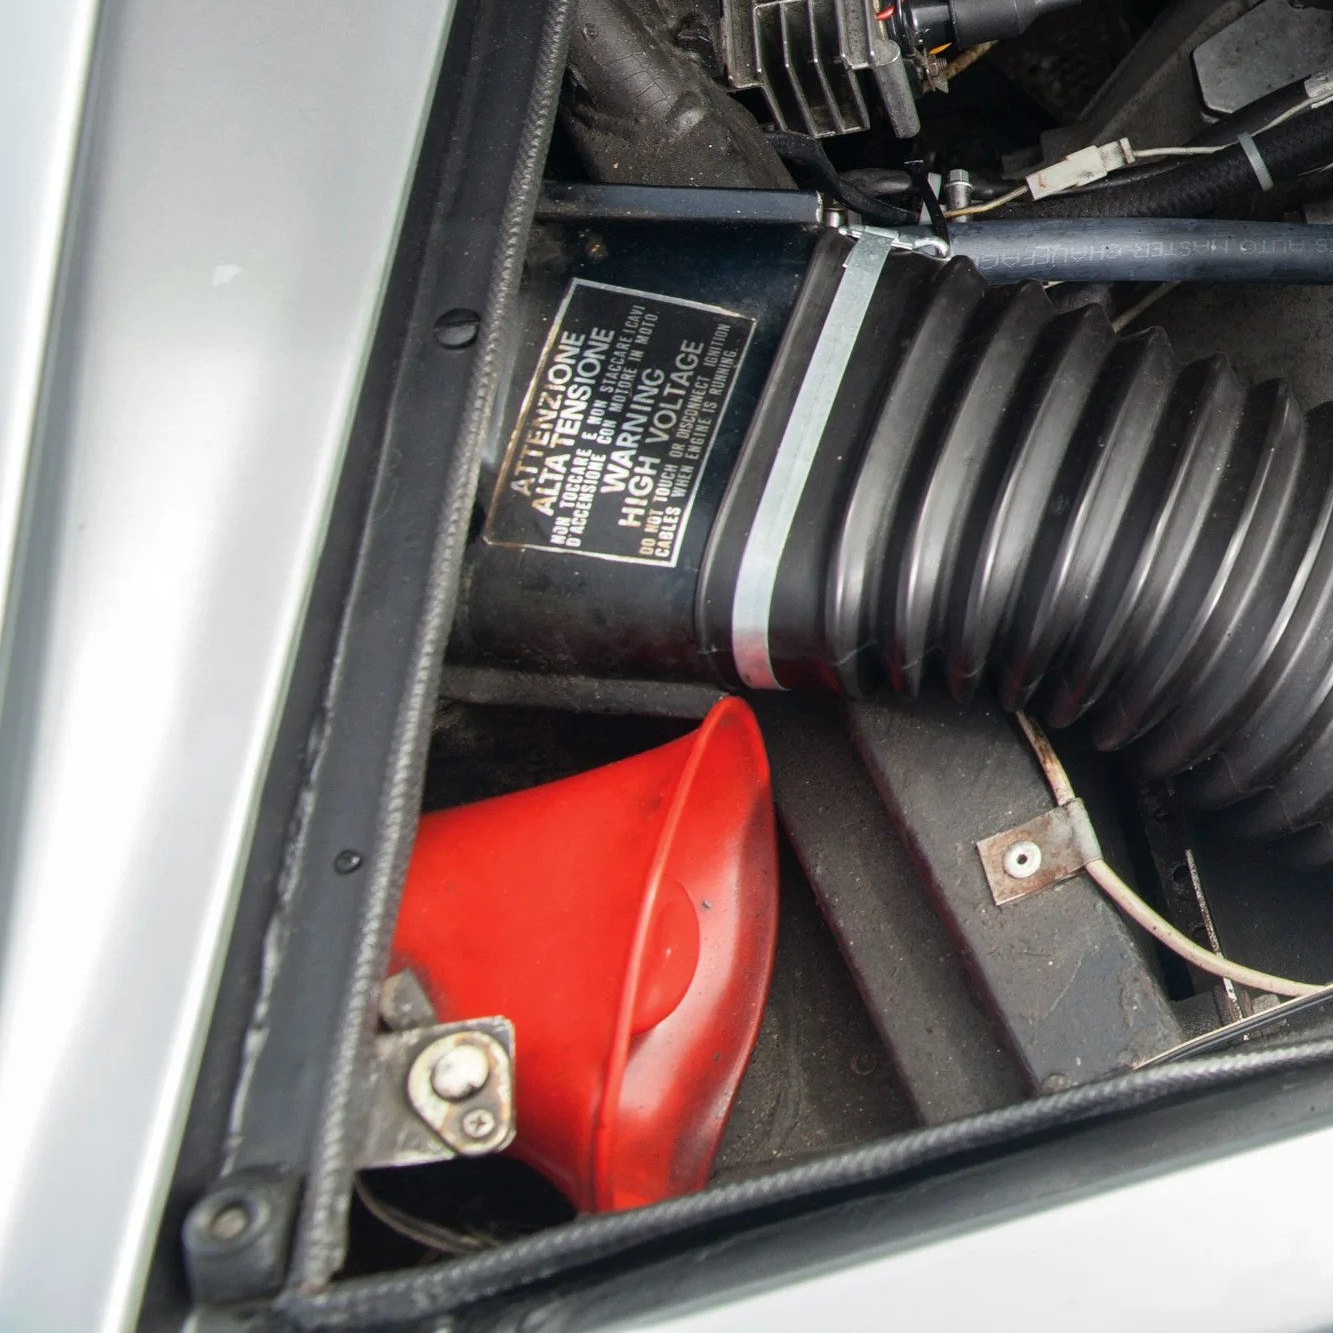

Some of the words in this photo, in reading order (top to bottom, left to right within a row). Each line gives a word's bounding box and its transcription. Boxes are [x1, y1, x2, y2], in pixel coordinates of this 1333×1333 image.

[602, 334, 633, 395] STACCARE
[704, 324, 731, 367] IGNITION
[511, 330, 586, 495] ATTENZIONE
[531, 454, 571, 517] ALTA
[552, 328, 615, 448] TENSIONE
[583, 429, 598, 442] E
[588, 399, 607, 425] NON
[601, 367, 666, 494] WARNING
[618, 456, 660, 528] HIGH
[645, 339, 704, 444] VOLTAGE
[675, 376, 710, 439] DISCONNECT
[566, 453, 606, 547] D'ACCENSIONE
[597, 420, 616, 444] CON
[610, 364, 638, 417] MOTORE
[628, 349, 642, 363] IN
[654, 507, 682, 558] CABLES
[671, 464, 693, 497] WHEN
[685, 417, 711, 460] ENGINE
[703, 402, 717, 415] IS
[711, 349, 737, 396] RUNNING.
[669, 441, 684, 458] OR
[562, 448, 593, 514] TOCCARE
[654, 464, 678, 502] TOUCH
[551, 517, 567, 545] NON
[640, 539, 655, 556] DO
[645, 509, 664, 534] NOT
